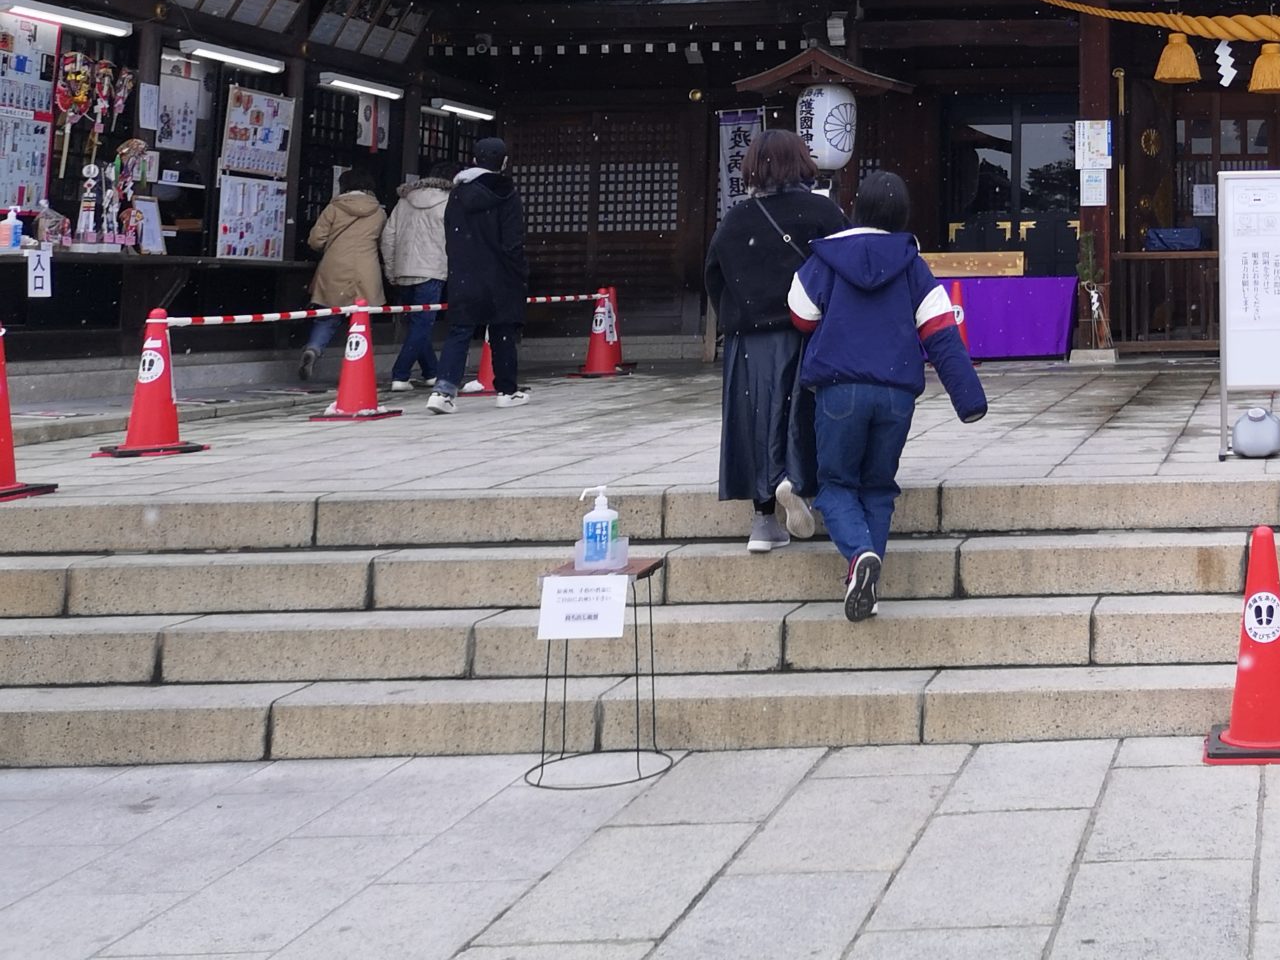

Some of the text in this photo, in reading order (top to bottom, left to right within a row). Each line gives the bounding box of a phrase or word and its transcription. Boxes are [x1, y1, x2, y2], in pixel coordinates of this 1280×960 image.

[728, 126, 752, 209] 疫病退
[33, 254, 46, 291] 入口
